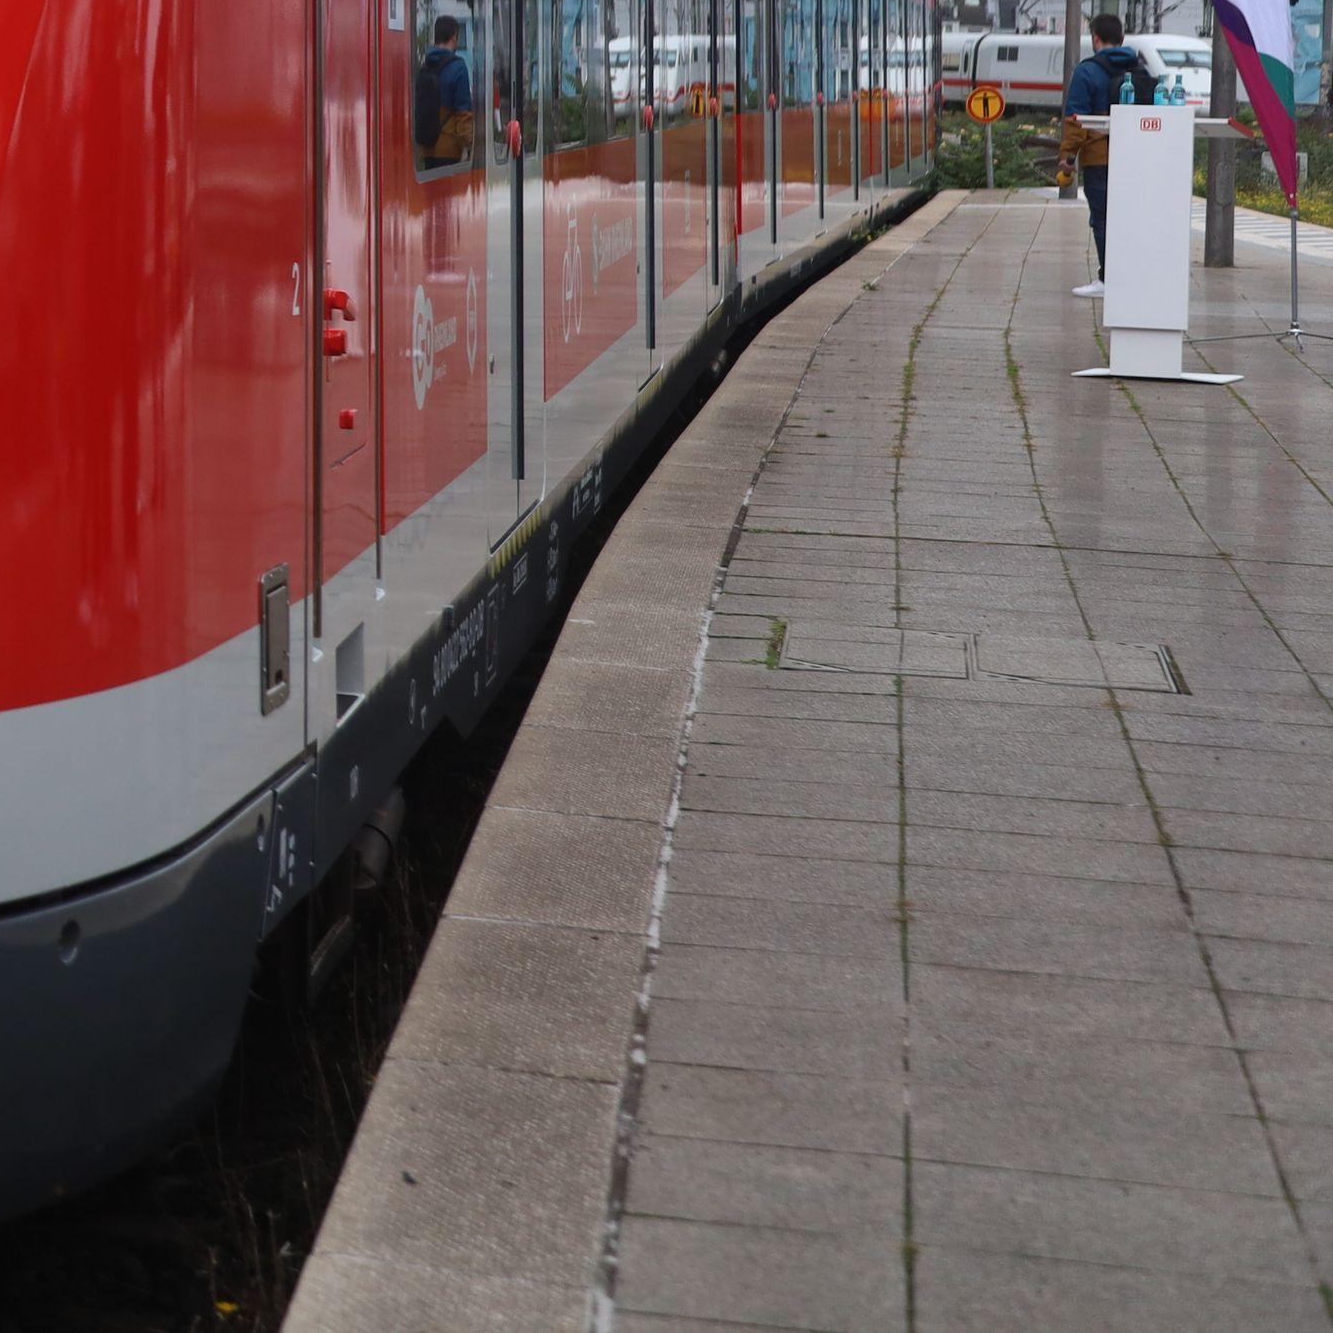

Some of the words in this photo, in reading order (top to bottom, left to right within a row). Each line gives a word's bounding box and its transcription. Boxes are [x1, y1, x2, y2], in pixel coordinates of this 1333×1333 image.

[1047, 46, 1064, 76] IC
[1142, 119, 1159, 130] DB
[292, 262, 301, 316] 2
